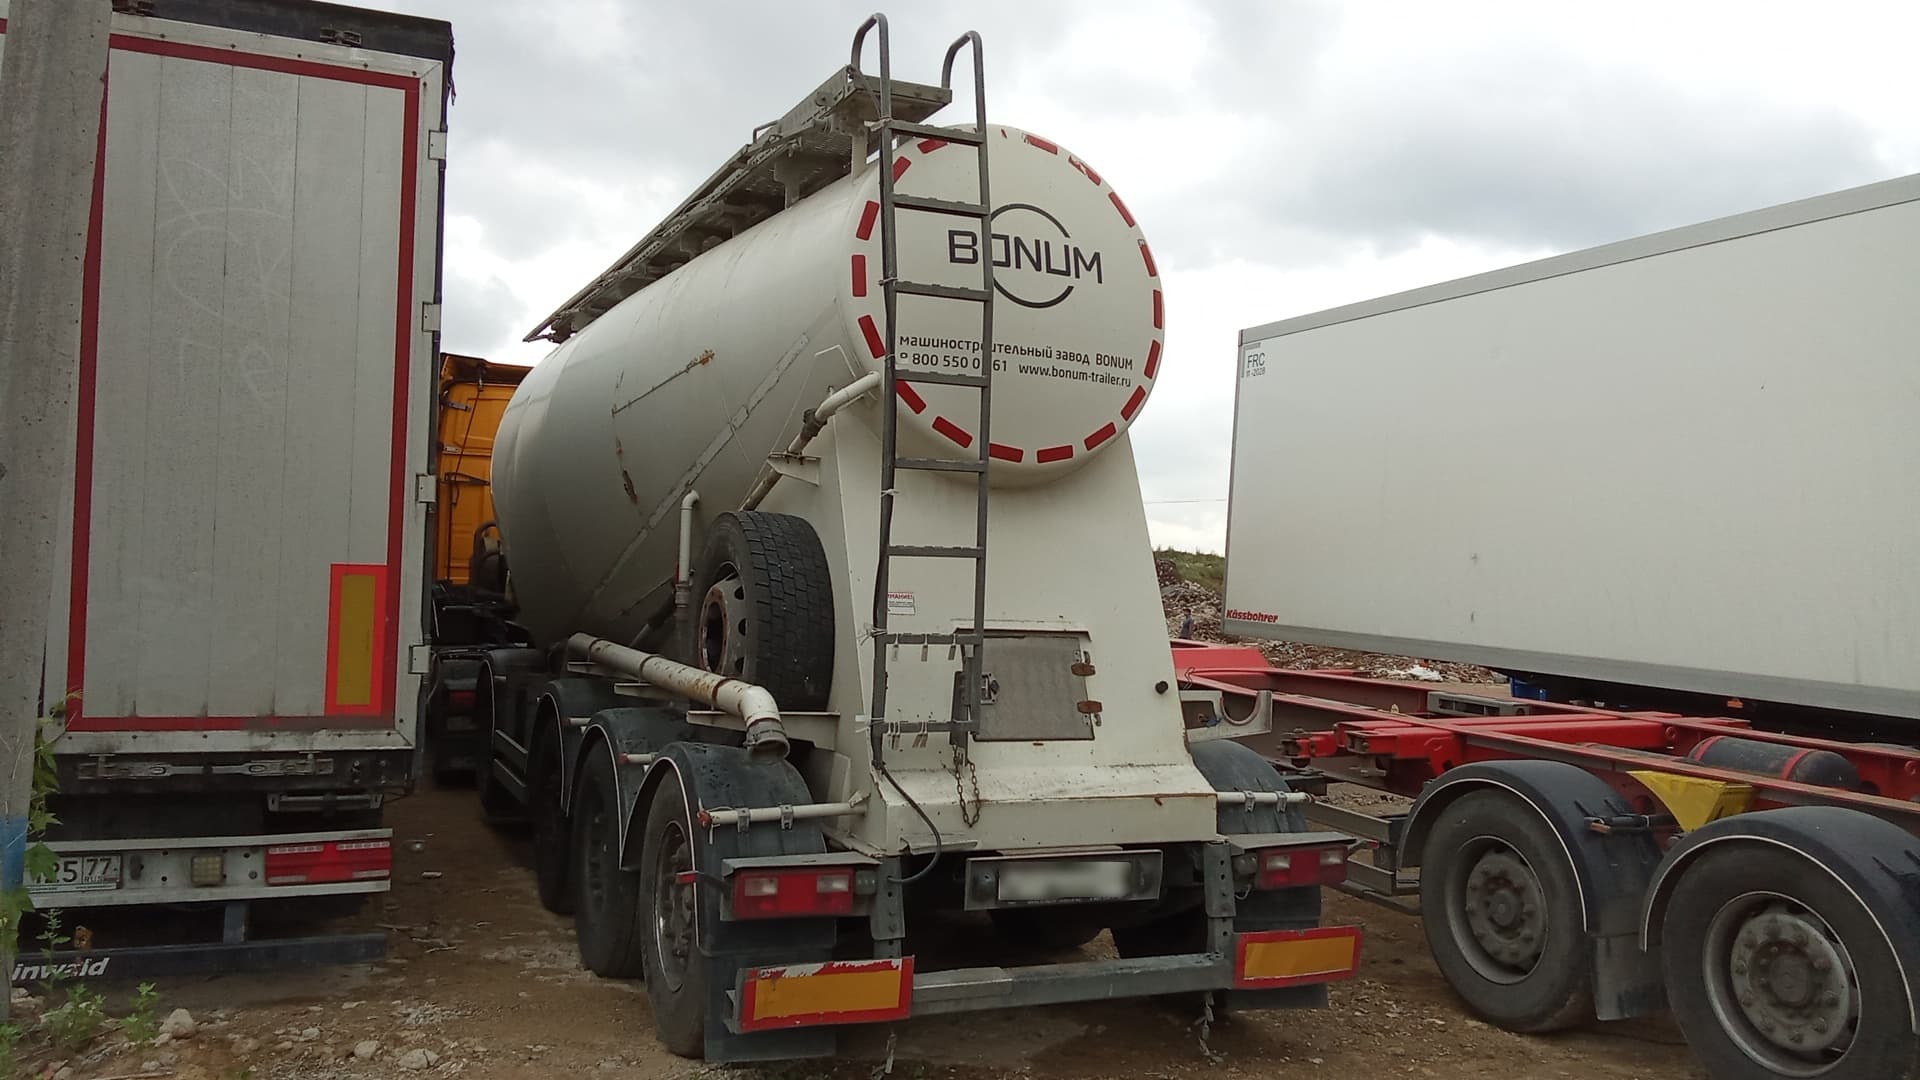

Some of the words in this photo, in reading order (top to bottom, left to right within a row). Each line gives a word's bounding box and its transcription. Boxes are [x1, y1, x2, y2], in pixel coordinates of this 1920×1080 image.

[948, 229, 1103, 284] BONUM
[912, 353, 939, 366] 800
[943, 355, 969, 369] 550
[993, 359, 1007, 372] 61
[1019, 364, 1131, 387] www.bonum-trailer.ru
[1055, 350, 1090, 366] завод
[1095, 353, 1133, 371] BONUM
[1247, 352, 1265, 368] FRC
[1226, 609, 1279, 623] Kässbohrer
[86, 857, 112, 876] 77
